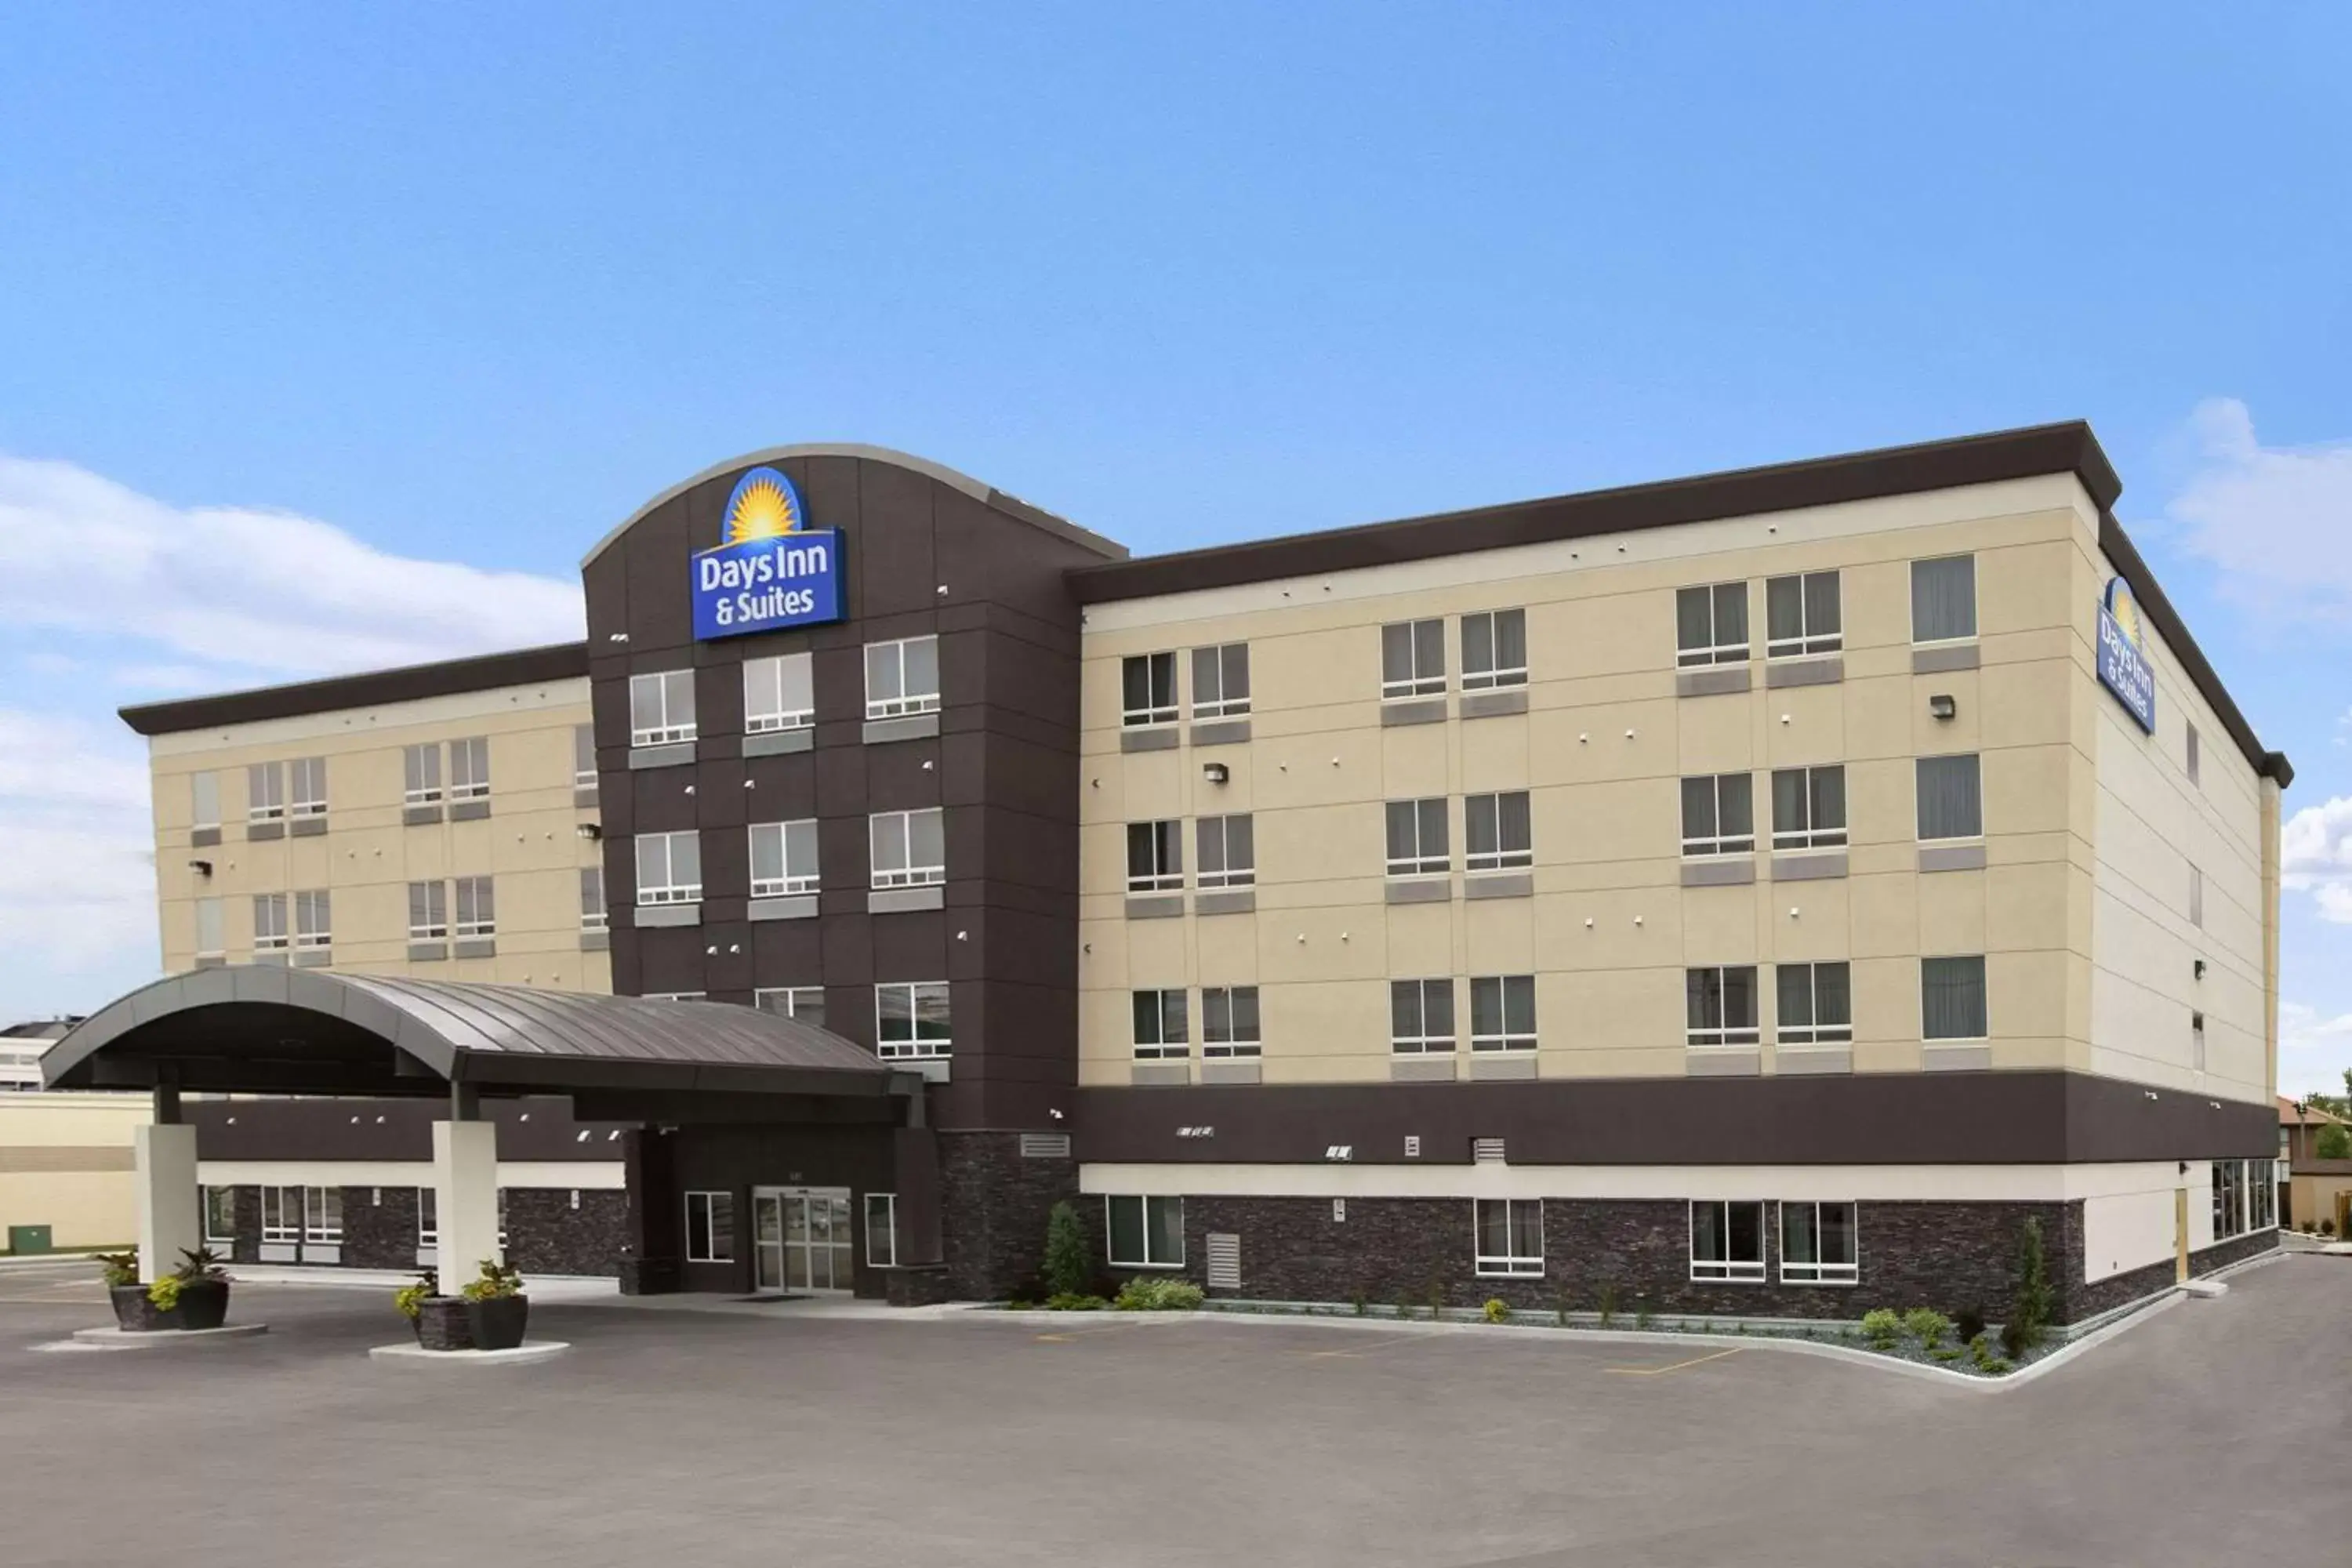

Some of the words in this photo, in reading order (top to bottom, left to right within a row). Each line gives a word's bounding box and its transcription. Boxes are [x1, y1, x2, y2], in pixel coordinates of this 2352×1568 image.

[701, 554, 773, 590] Days
[777, 545, 827, 579] Inn
[716, 597, 734, 625] &
[738, 586, 814, 622] Suites
[2102, 612, 2132, 672] Days
[2133, 655, 2152, 698] Inn
[2108, 656, 2116, 681] &
[2118, 666, 2147, 719] Suites
